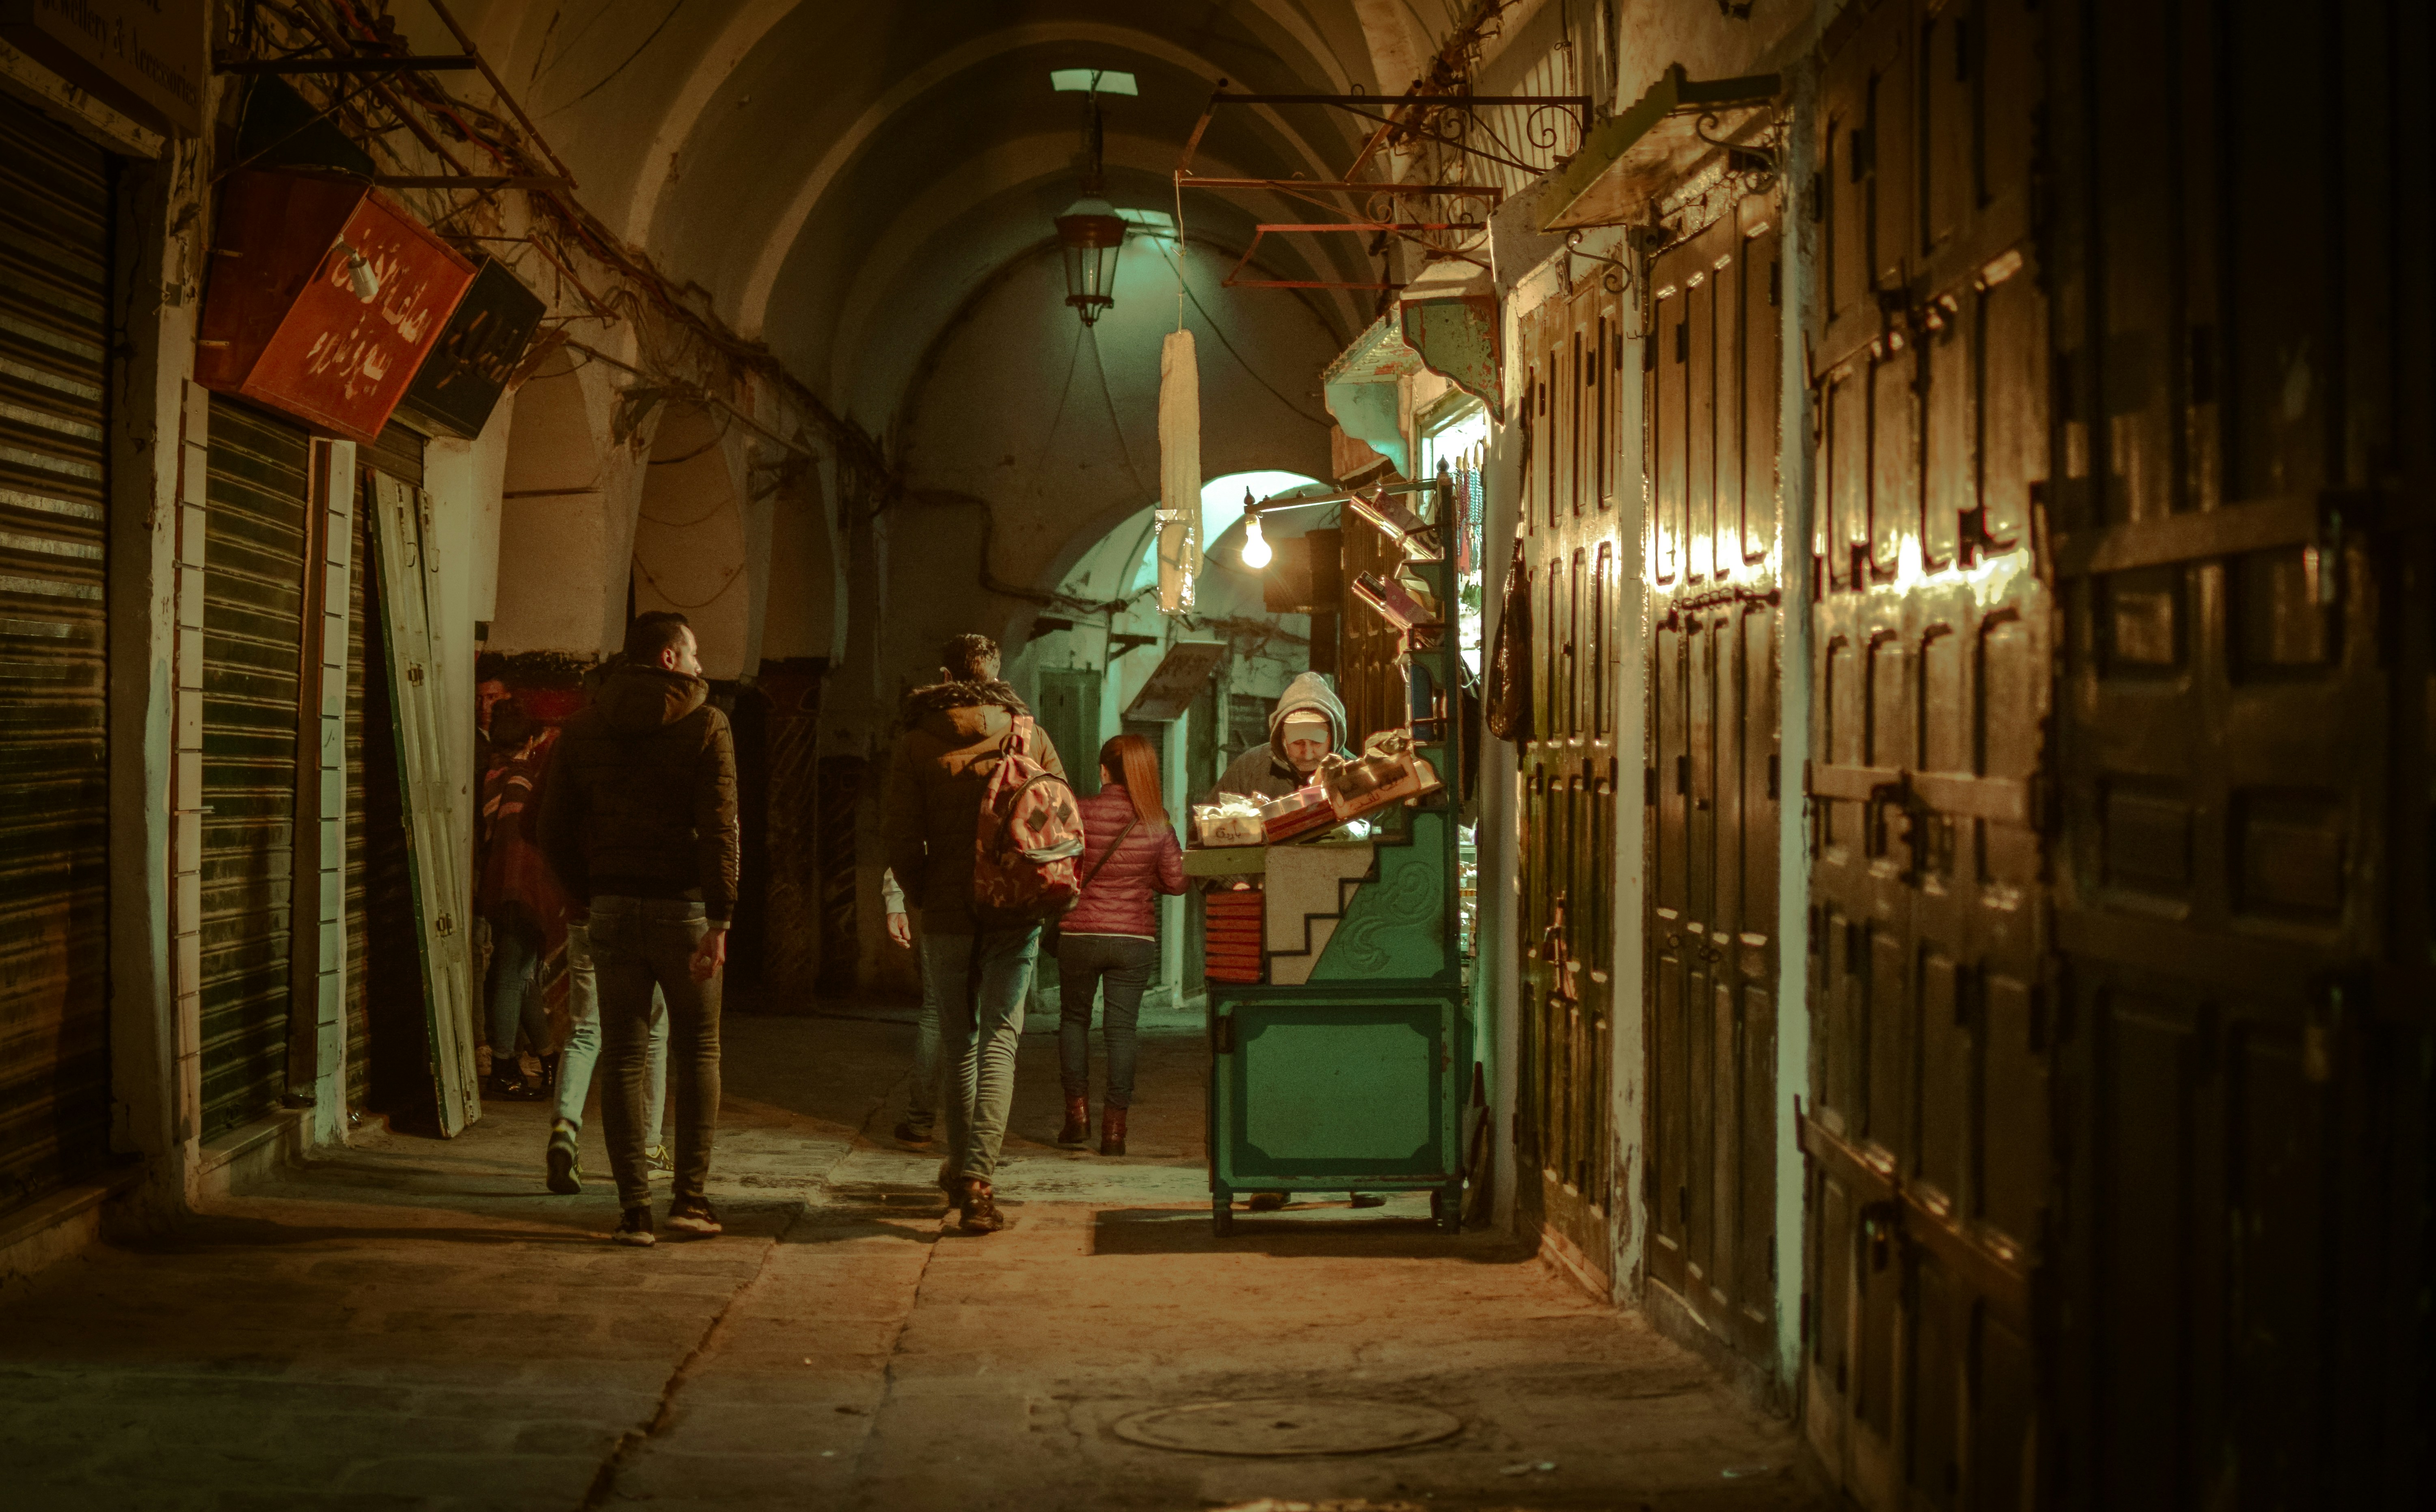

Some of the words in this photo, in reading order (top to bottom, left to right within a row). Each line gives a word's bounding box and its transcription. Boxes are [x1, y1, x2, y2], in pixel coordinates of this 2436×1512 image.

[43, 0, 108, 59] wellery
[113, 15, 125, 58] &
[129, 26, 197, 109] Accessories
